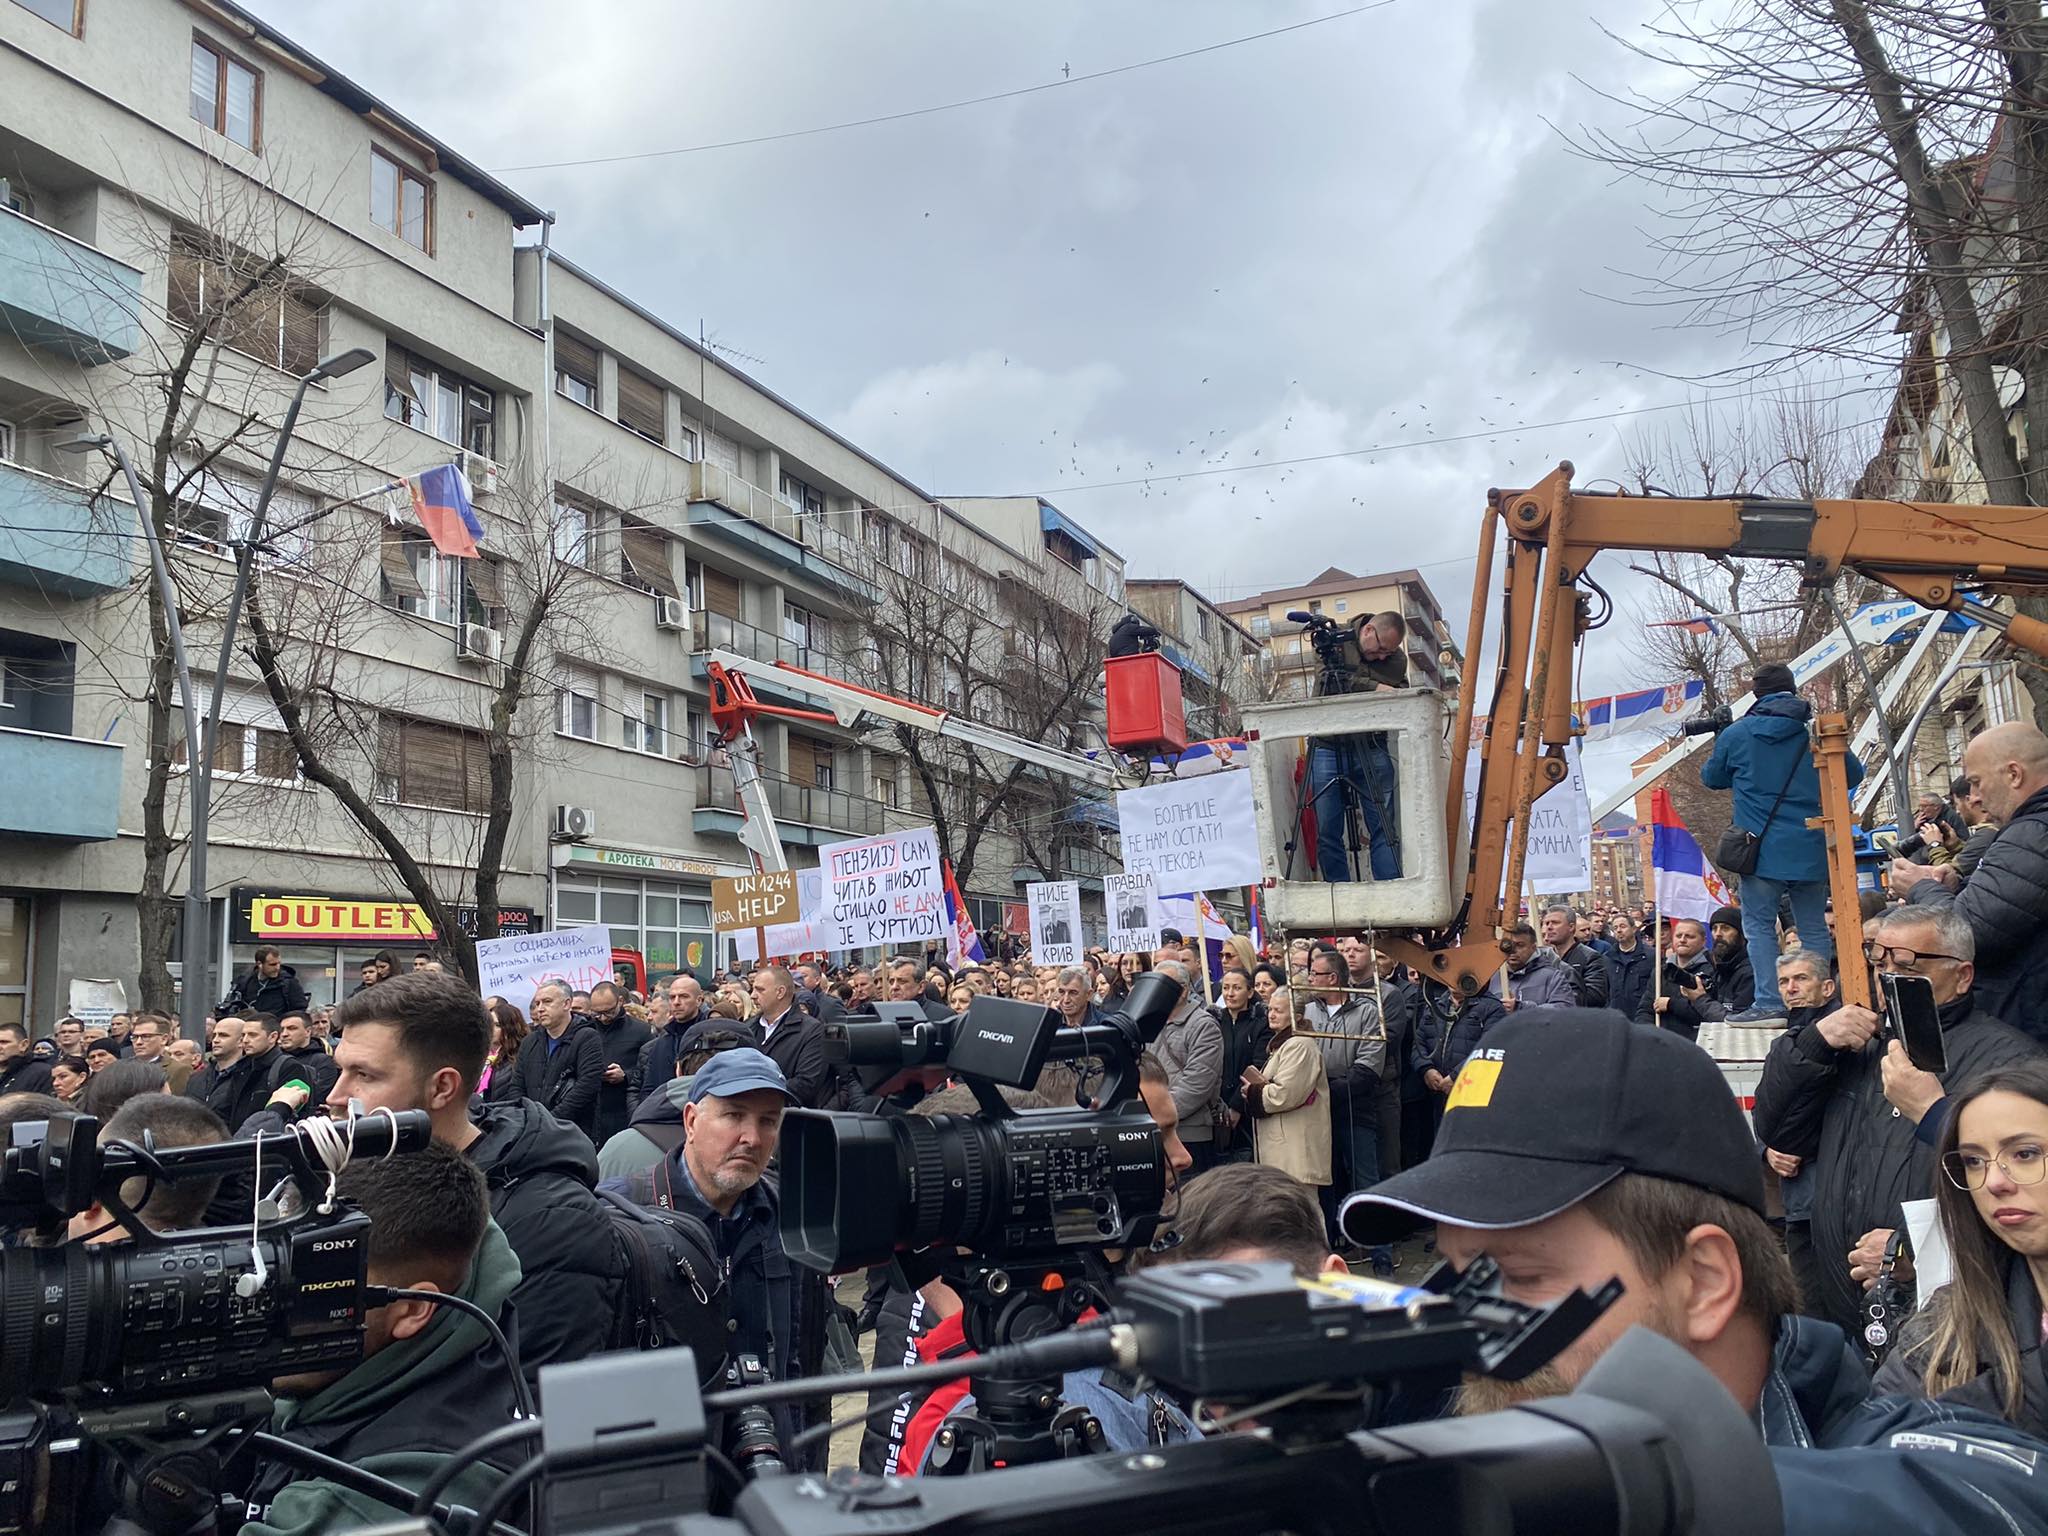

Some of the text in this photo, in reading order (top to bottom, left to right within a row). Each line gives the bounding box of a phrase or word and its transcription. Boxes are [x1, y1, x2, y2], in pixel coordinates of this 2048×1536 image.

[1154, 799, 1217, 825] БОЛНИЦЕ
[1145, 831, 1169, 850] НАМ
[1172, 822, 1223, 847] ОСТАТИ
[608, 852, 718, 875] APOTEKA MOC PRIRODE
[832, 840, 931, 877] ПЕНЗИЈУ САМ
[1157, 850, 1206, 873] ЛЕКОВА
[734, 876, 756, 894] UN
[760, 873, 791, 893] 1244
[833, 876, 876, 903] ЧИТАВ
[885, 866, 931, 892] ЖИВОТ
[1037, 884, 1069, 903] НИЈЕ
[1106, 873, 1153, 892] ПРАВДА
[264, 903, 417, 928] OUTLET
[504, 911, 528, 922] DOCA
[714, 910, 735, 924] USA
[738, 894, 786, 923] HELP
[833, 899, 887, 922] СТИЦАО
[894, 895, 911, 915] НЕ
[913, 891, 944, 915] ДАМ
[498, 928, 529, 938] EGEND
[839, 926, 855, 945] ЈЕ
[868, 910, 943, 941] КУРТИЈУ!
[1042, 946, 1074, 963] КРИВ
[1109, 932, 1158, 954] СЛАЂАНА
[1485, 1048, 1506, 1060] FE
[1118, 1131, 1149, 1141] SONY
[951, 1178, 962, 1188] G
[312, 1239, 357, 1252] SONY
[904, 1336, 918, 1370] FIL
[884, 1444, 900, 1478] FIL
